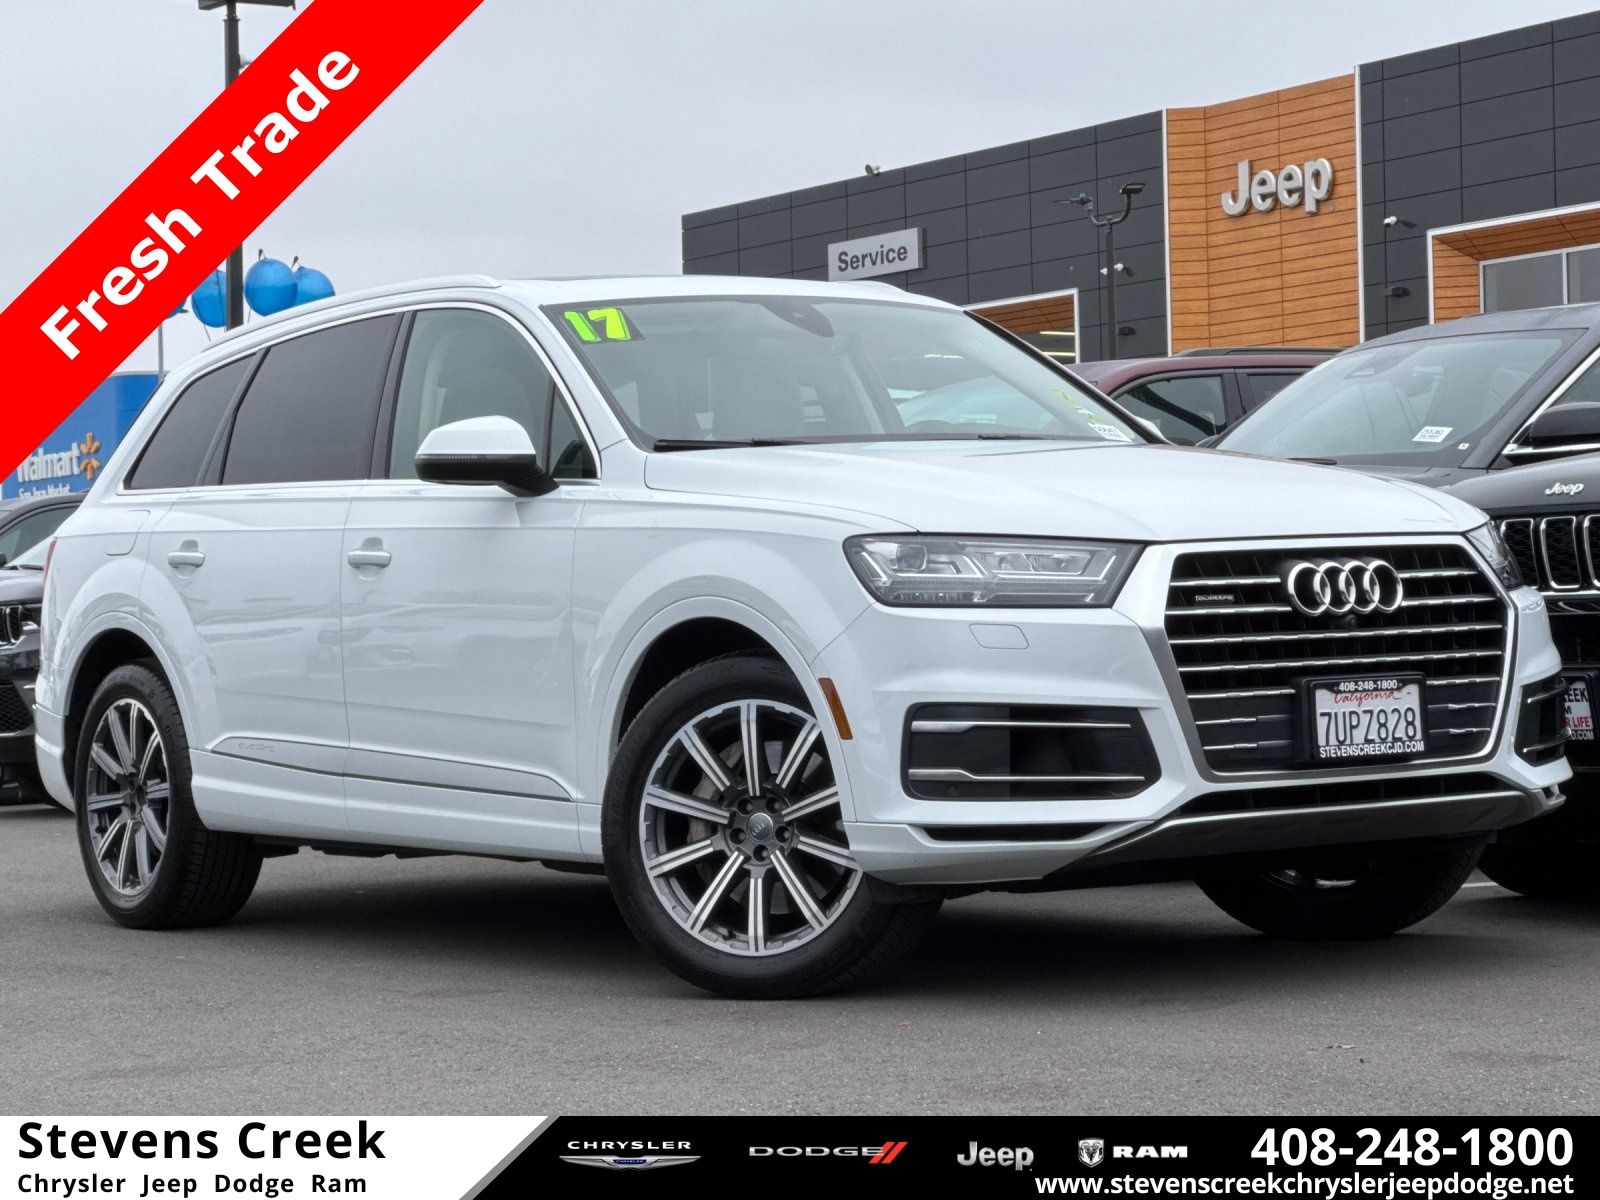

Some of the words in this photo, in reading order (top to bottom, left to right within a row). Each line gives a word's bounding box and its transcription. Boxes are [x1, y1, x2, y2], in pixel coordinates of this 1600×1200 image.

[1221, 157, 1334, 216] Jeep
[838, 244, 908, 272] Service
[564, 307, 631, 342] 17
[1544, 482, 1585, 496] Jeep
[1338, 680, 1398, 692] 408-248-1800
[1319, 707, 1418, 746] 7UPZ828
[1572, 716, 1590, 728] LIFE
[1319, 741, 1425, 758] STEVENSCREEKCJD.COM
